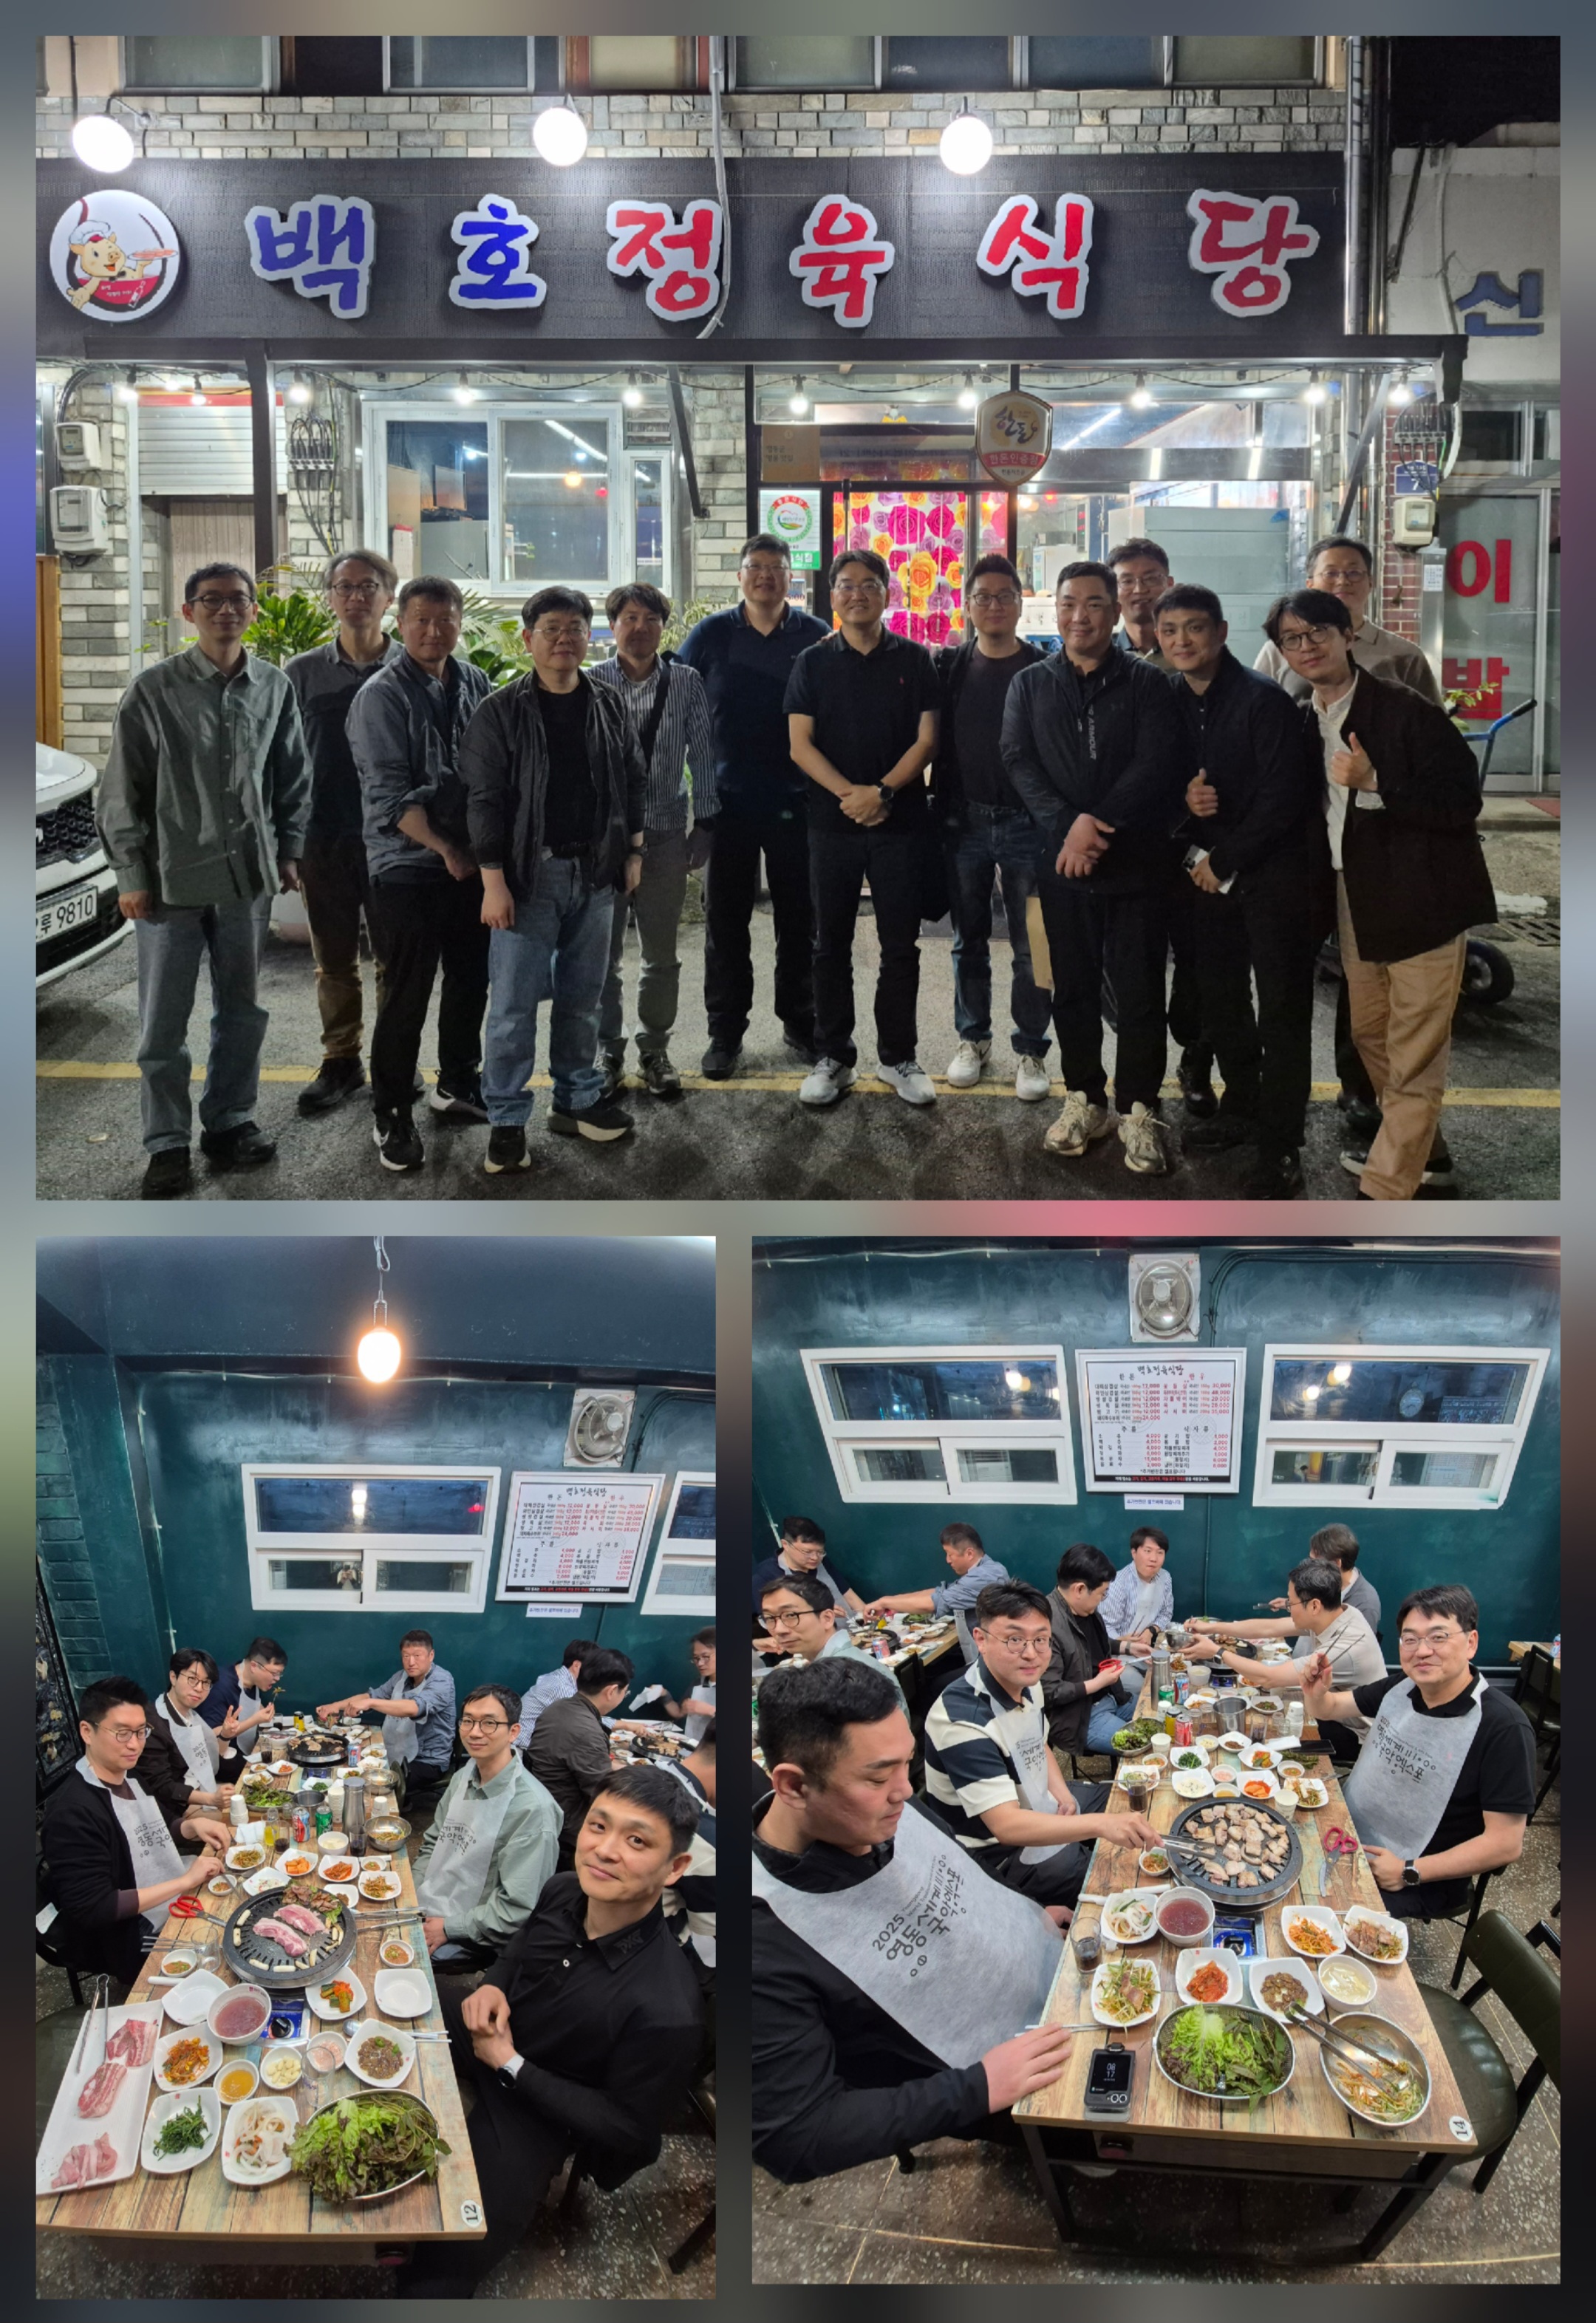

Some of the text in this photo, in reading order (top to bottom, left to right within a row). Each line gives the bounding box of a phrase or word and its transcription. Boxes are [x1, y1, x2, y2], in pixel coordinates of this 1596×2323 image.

[1455, 268, 1544, 336] 신
[56, 894, 93, 929] 9810
[873, 1914, 904, 1951] 2025
[1453, 2121, 1468, 2136] 14
[464, 2205, 479, 2222] 12
